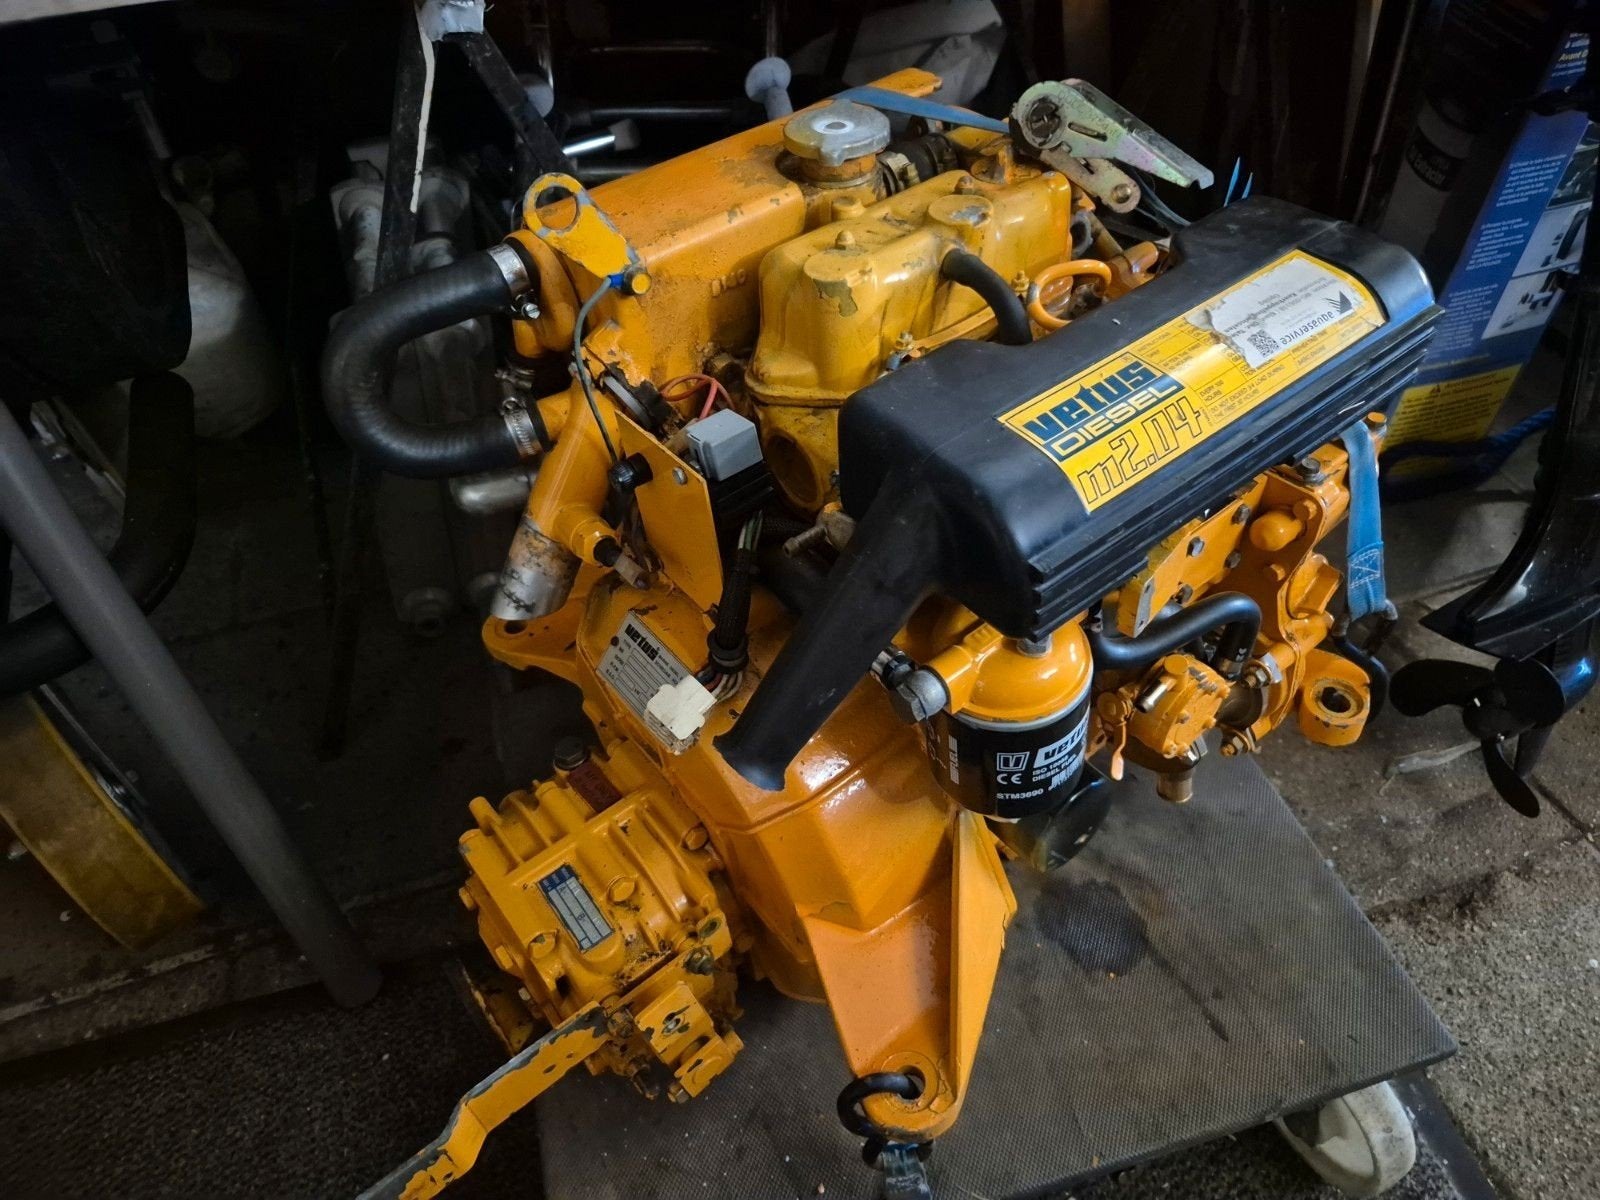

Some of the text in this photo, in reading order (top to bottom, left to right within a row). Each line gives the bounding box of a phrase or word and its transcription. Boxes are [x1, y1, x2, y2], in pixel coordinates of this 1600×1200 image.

[1279, 311, 1335, 345] aquaservice
[1023, 361, 1157, 441] vetus
[1051, 385, 1177, 456] DIESEL
[1078, 396, 1202, 504] m2.04
[1032, 767, 1060, 782] DIESEL
